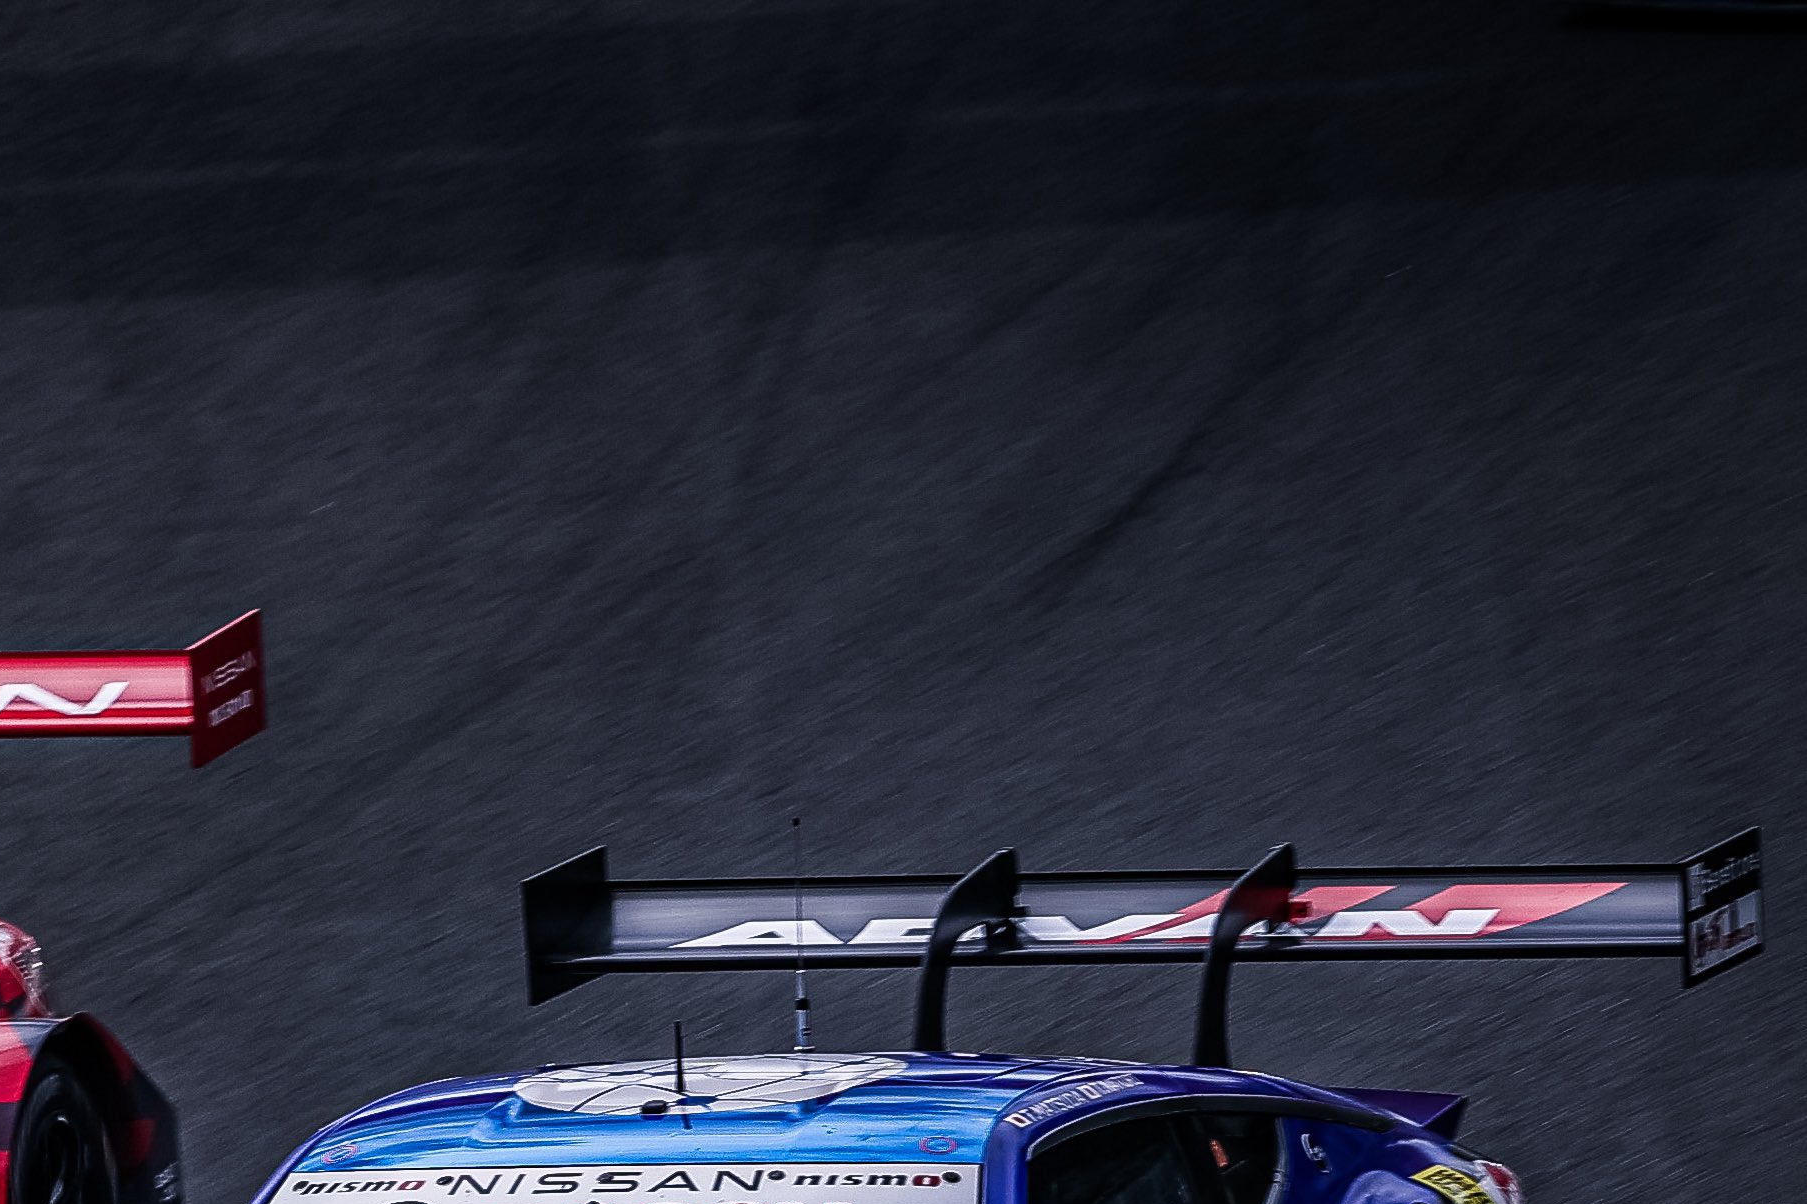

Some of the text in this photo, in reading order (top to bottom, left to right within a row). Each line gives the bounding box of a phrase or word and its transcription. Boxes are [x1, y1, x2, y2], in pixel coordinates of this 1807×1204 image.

[309, 1171, 941, 1197] nismo NISSAN nismo
